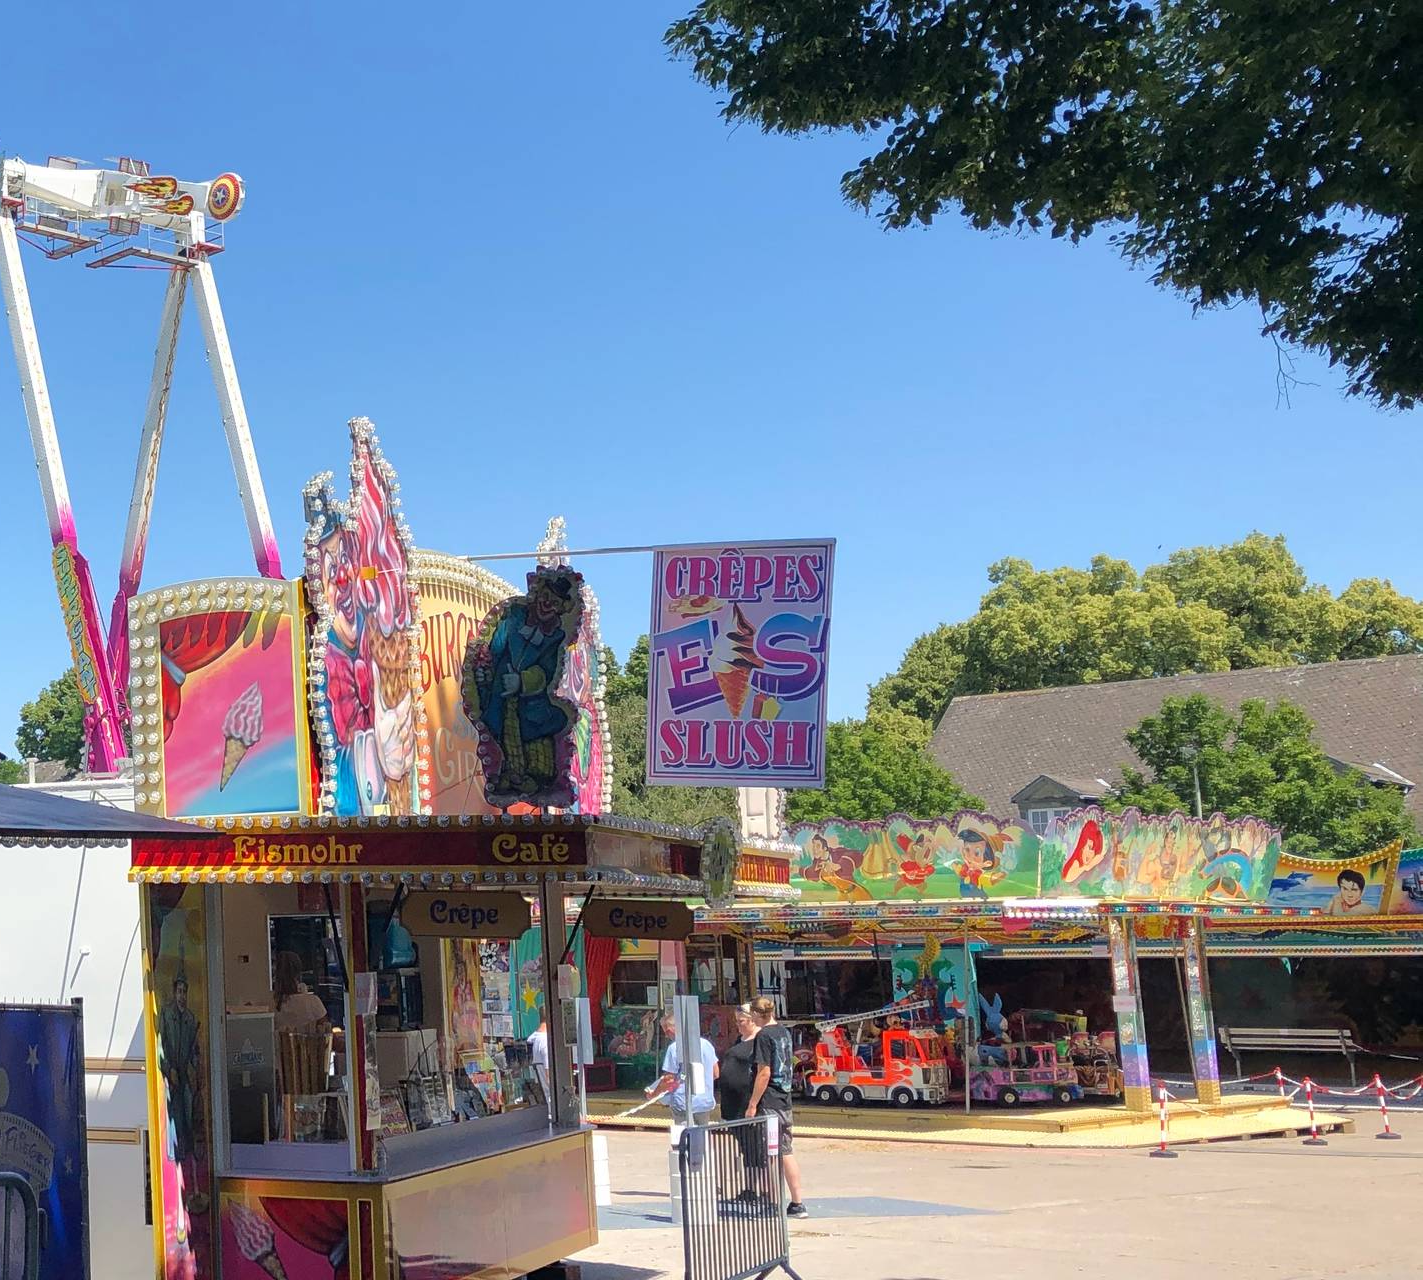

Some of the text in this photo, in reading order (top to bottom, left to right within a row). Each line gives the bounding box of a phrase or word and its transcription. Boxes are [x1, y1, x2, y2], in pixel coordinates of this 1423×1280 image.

[664, 548, 824, 603] CRÊPES
[660, 720, 816, 770] SLUSH
[232, 833, 570, 864] Eismohr Café
[430, 899, 498, 930] Crêpe
